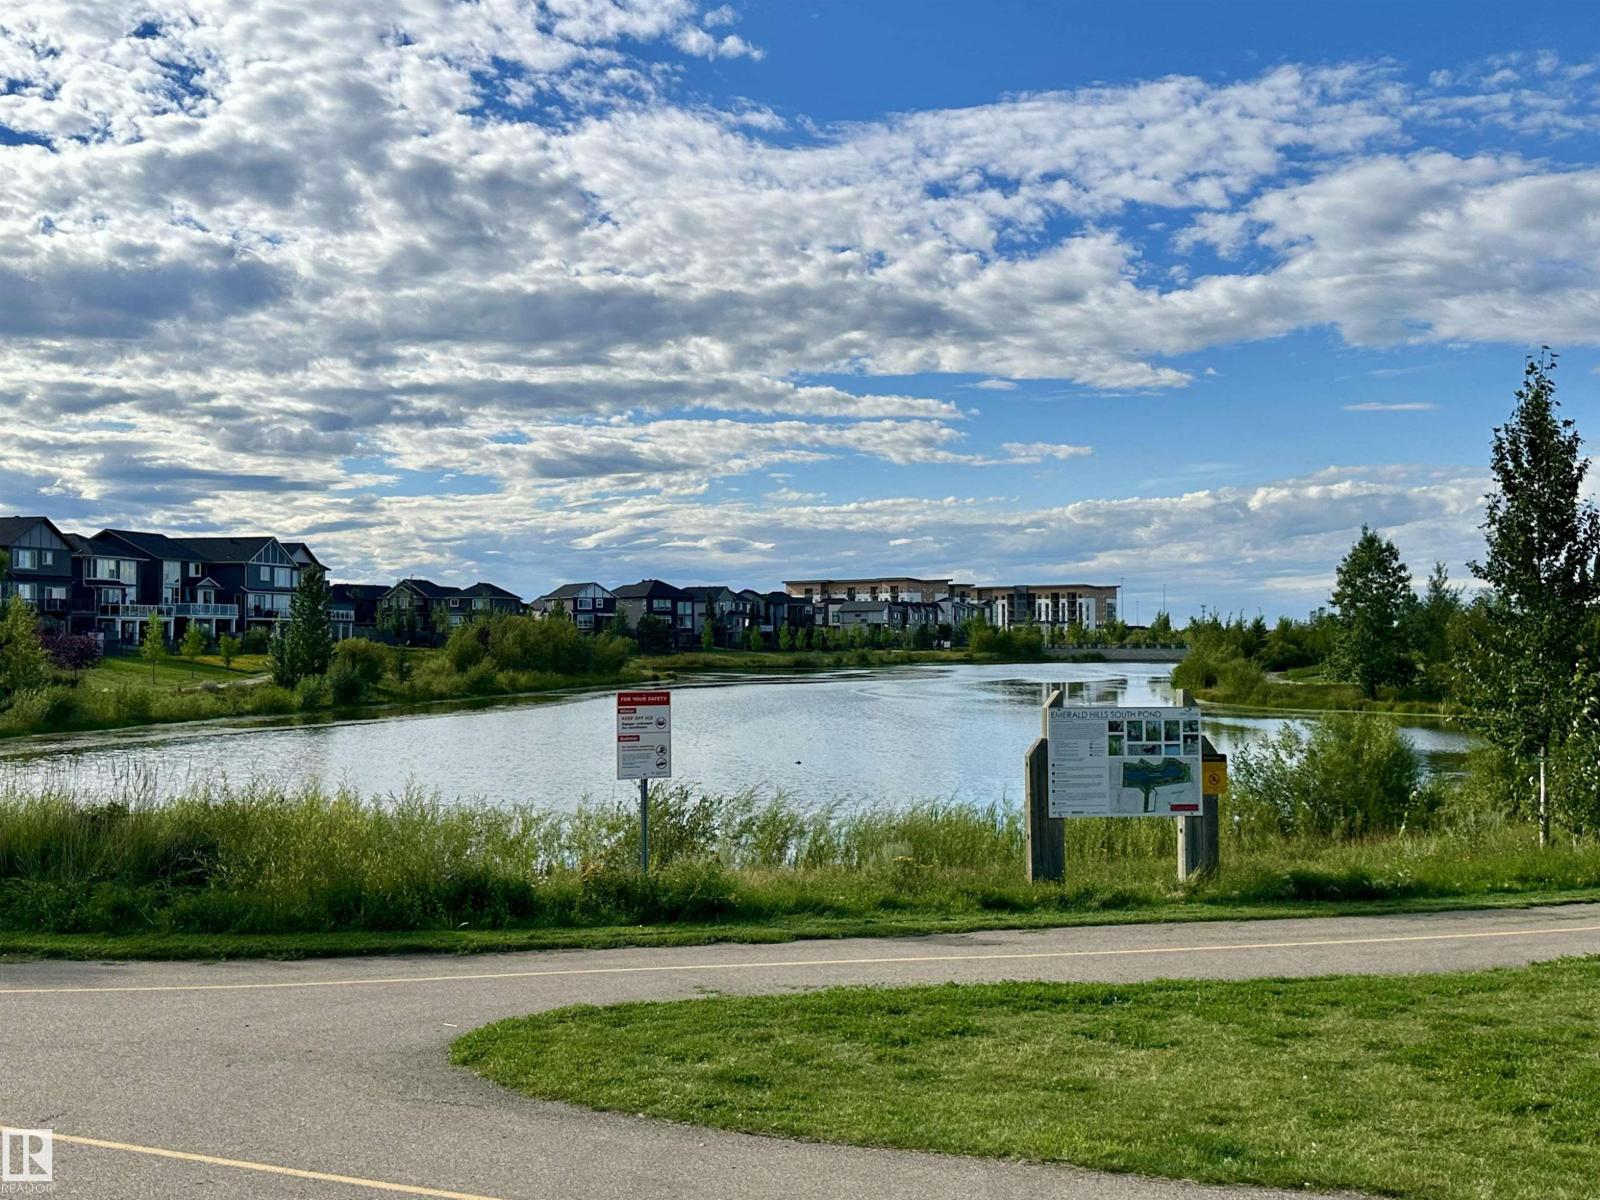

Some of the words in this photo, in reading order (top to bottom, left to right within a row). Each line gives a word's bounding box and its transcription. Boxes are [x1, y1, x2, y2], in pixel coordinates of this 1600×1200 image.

[1051, 711, 1087, 719] EMERALD
[1110, 710, 1136, 718] SOUTH
[1138, 710, 1162, 718] POND
